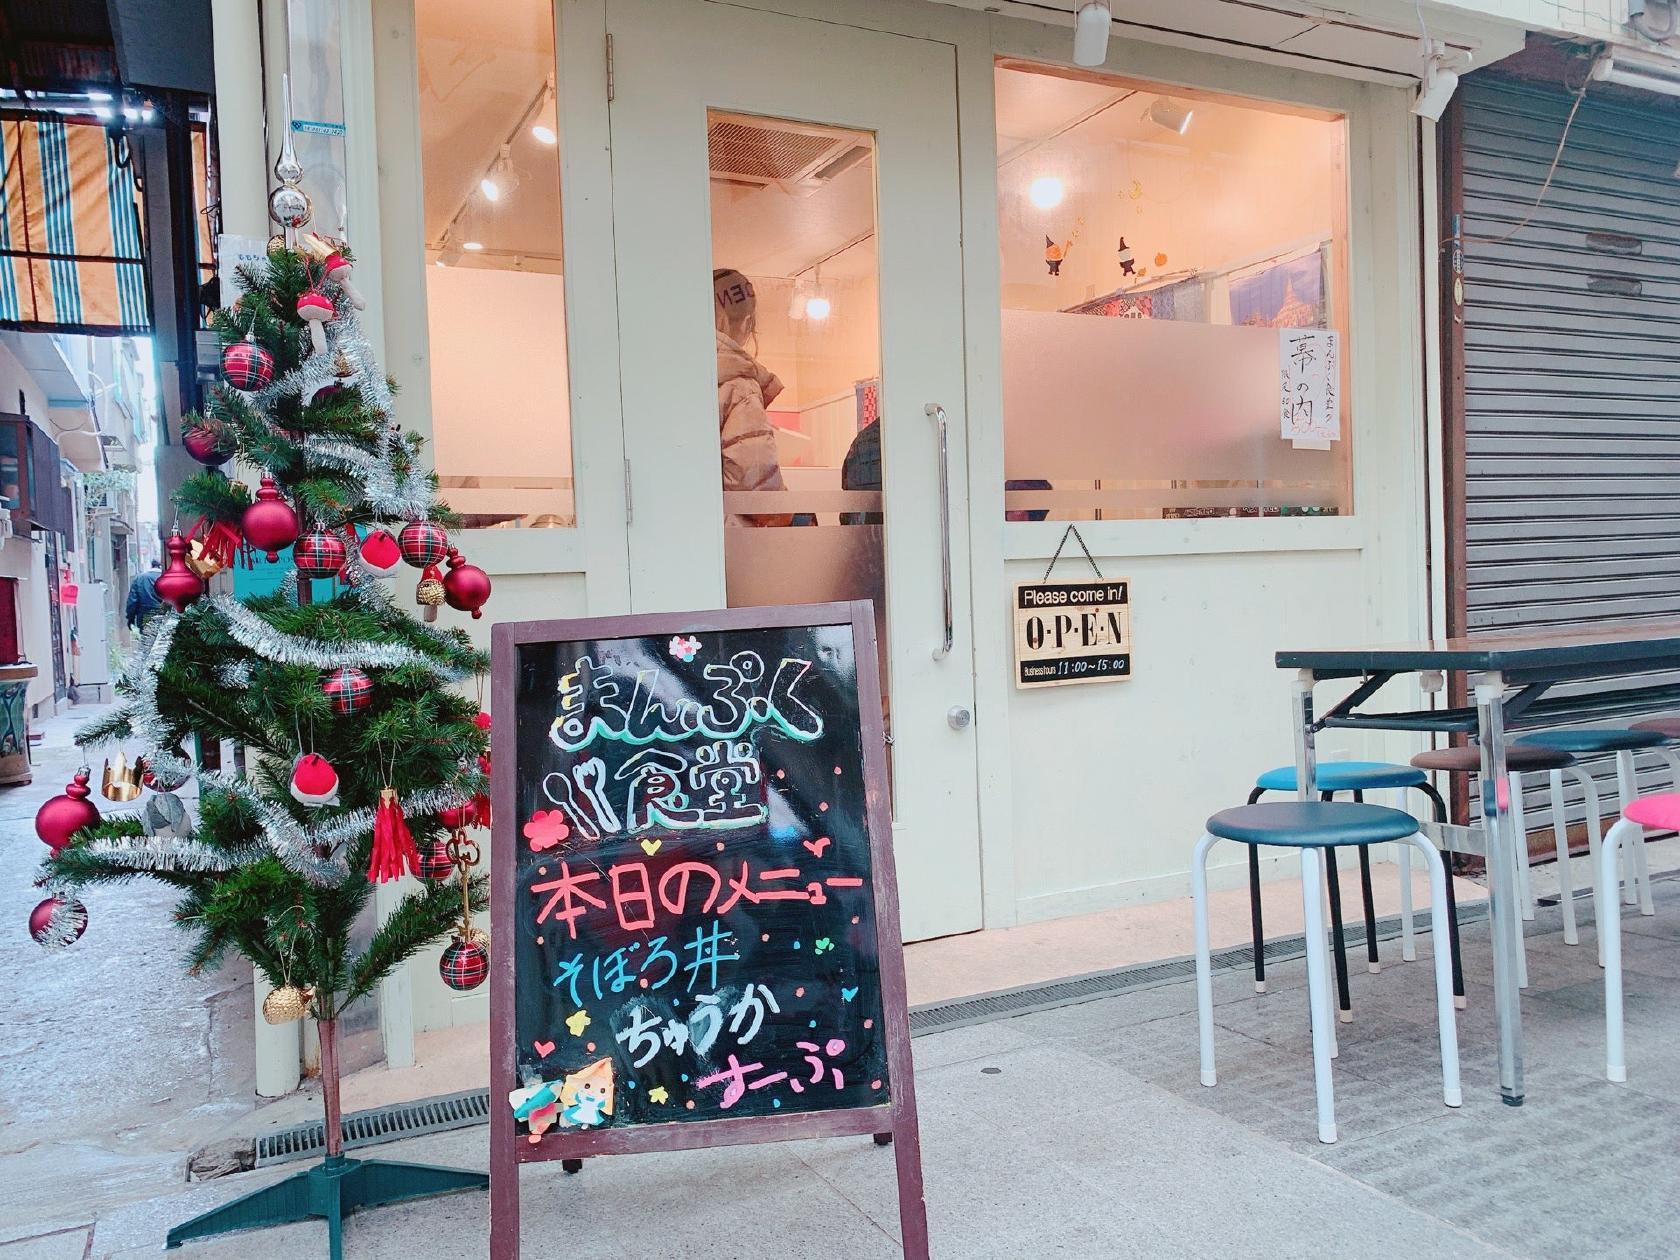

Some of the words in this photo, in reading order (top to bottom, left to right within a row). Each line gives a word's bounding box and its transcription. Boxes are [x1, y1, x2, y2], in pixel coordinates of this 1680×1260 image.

[1289, 335, 1316, 425] 幕の内
[1024, 590, 1067, 606] Please
[1069, 588, 1105, 603] come
[1107, 586, 1123, 601] in!
[549, 650, 824, 751] まんぷく
[1024, 667, 1044, 677] Business
[614, 740, 769, 834] 食堂
[530, 860, 863, 940] 本日のメニュー
[614, 983, 781, 1069] ちゅうか
[694, 1038, 846, 1109] すーぷ
